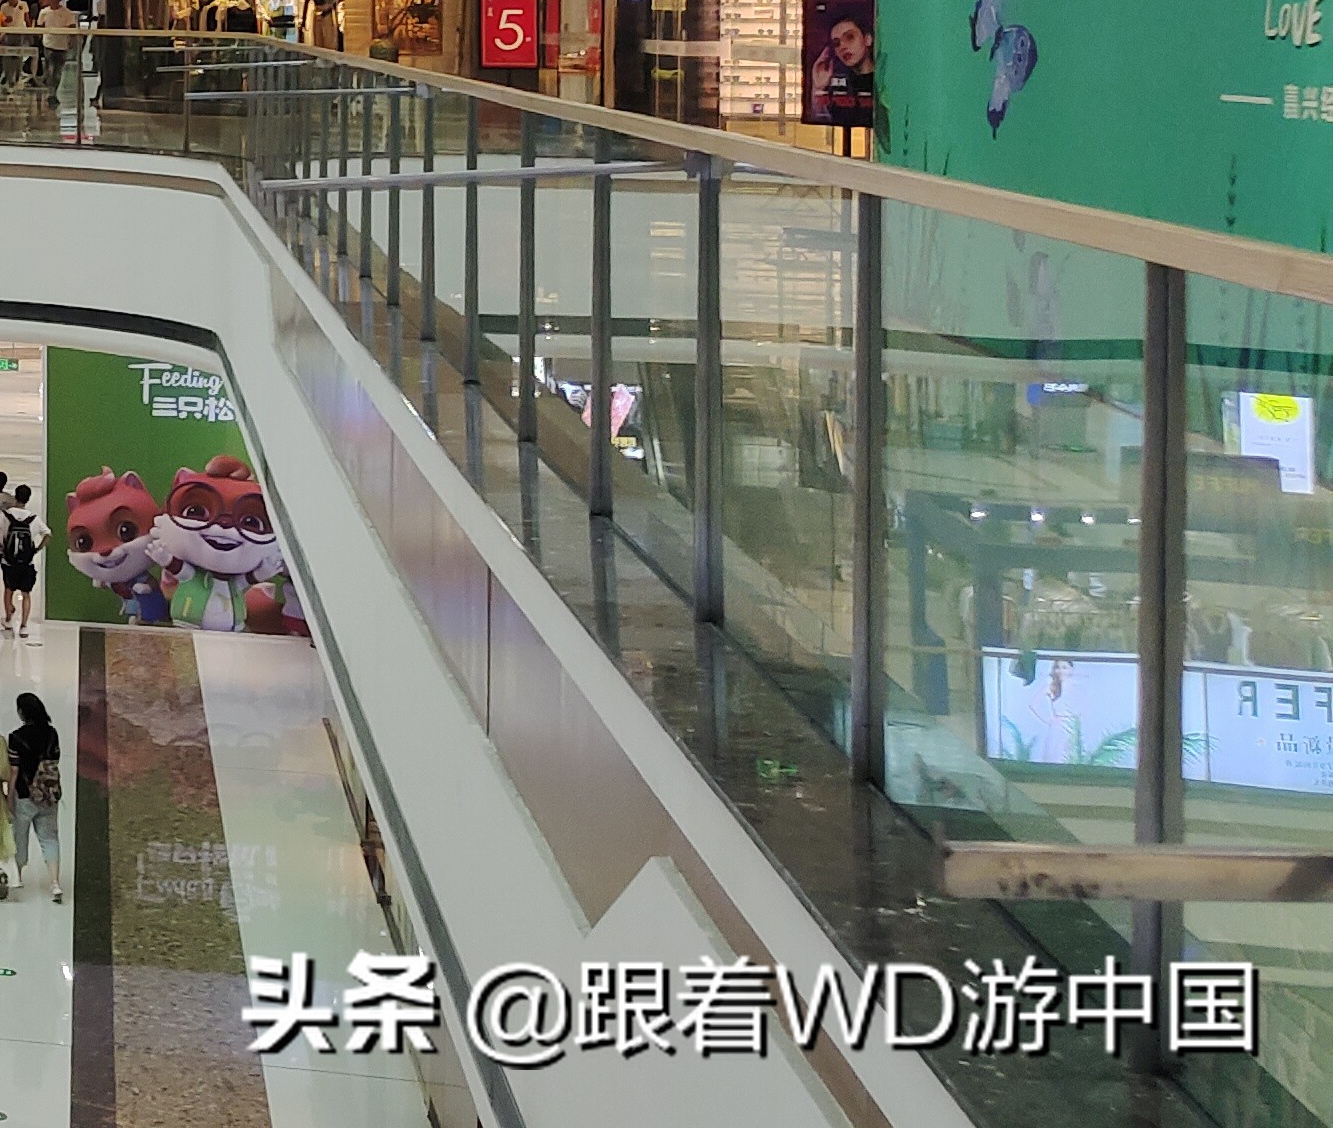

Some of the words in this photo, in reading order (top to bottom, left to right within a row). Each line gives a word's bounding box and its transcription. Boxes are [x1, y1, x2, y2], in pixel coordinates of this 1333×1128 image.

[494, 8, 525, 51] 5
[127, 362, 225, 406] Feeding
[151, 396, 235, 423] 三只松
